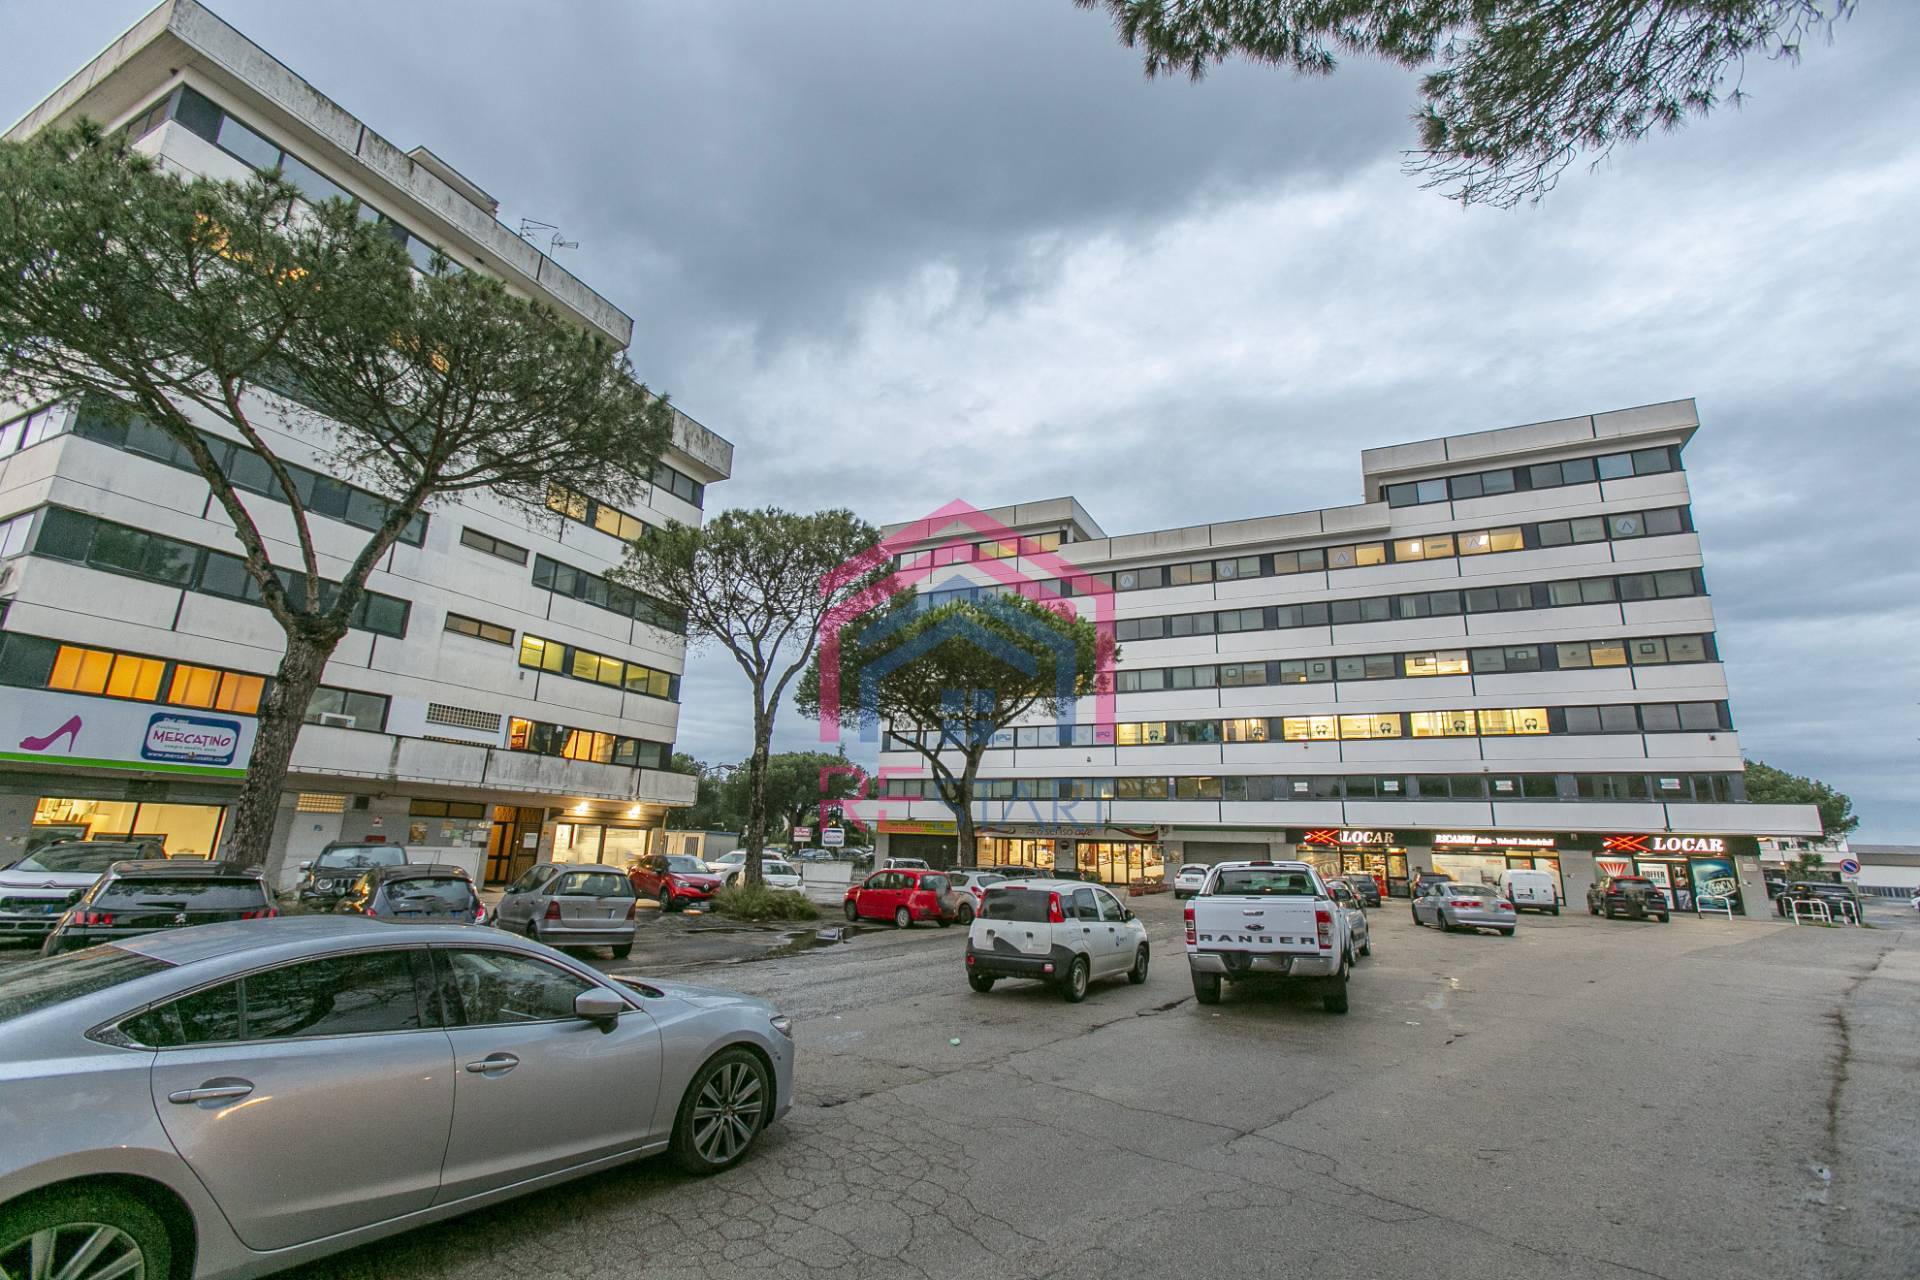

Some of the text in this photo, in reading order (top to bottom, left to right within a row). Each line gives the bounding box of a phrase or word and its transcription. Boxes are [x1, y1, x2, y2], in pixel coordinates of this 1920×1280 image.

[153, 730, 231, 747] MERCATINO
[1340, 831, 1394, 844] LOCAR
[1653, 837, 1724, 852] LOCAR
[1199, 934, 1315, 945] RANGER
